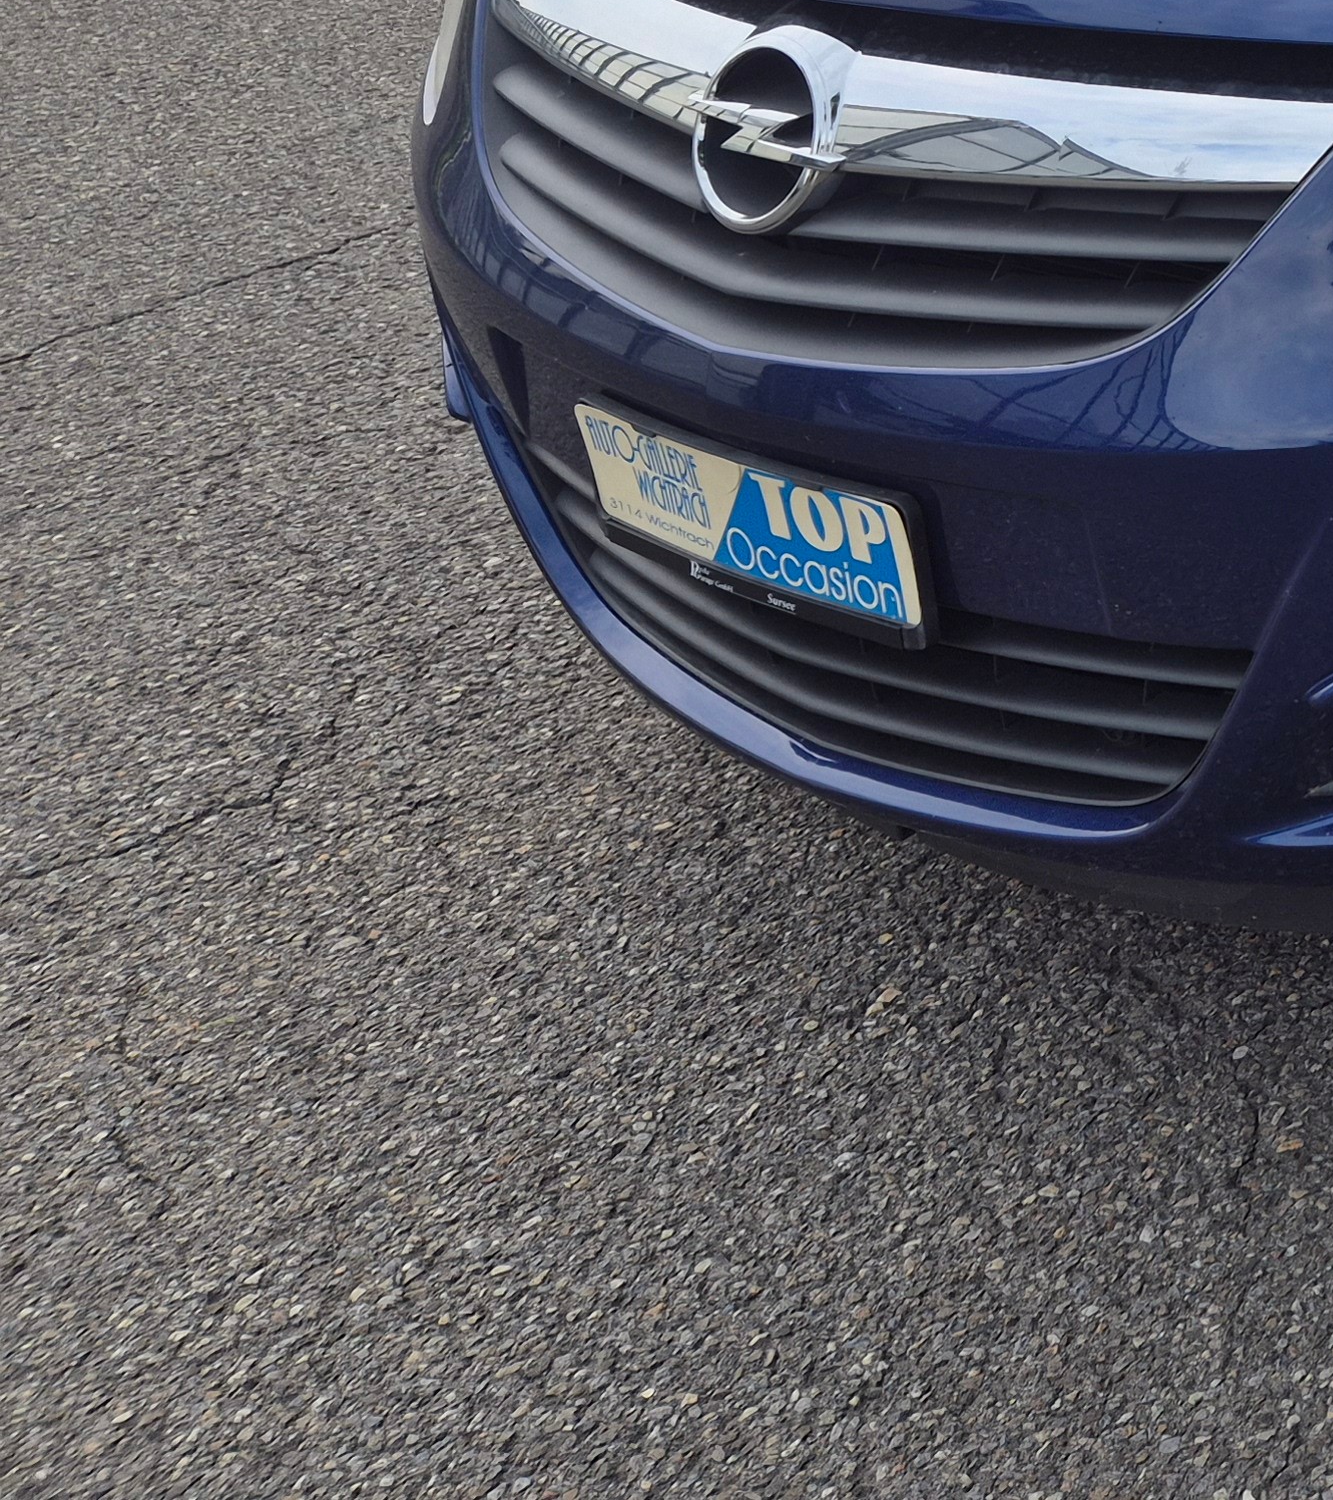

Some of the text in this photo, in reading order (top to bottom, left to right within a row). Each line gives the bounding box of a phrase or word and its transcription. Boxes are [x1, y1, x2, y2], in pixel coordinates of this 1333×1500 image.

[609, 497, 715, 551] 3114 Wichtrach
[748, 472, 886, 564] TOP
[726, 527, 903, 618] Occasion
